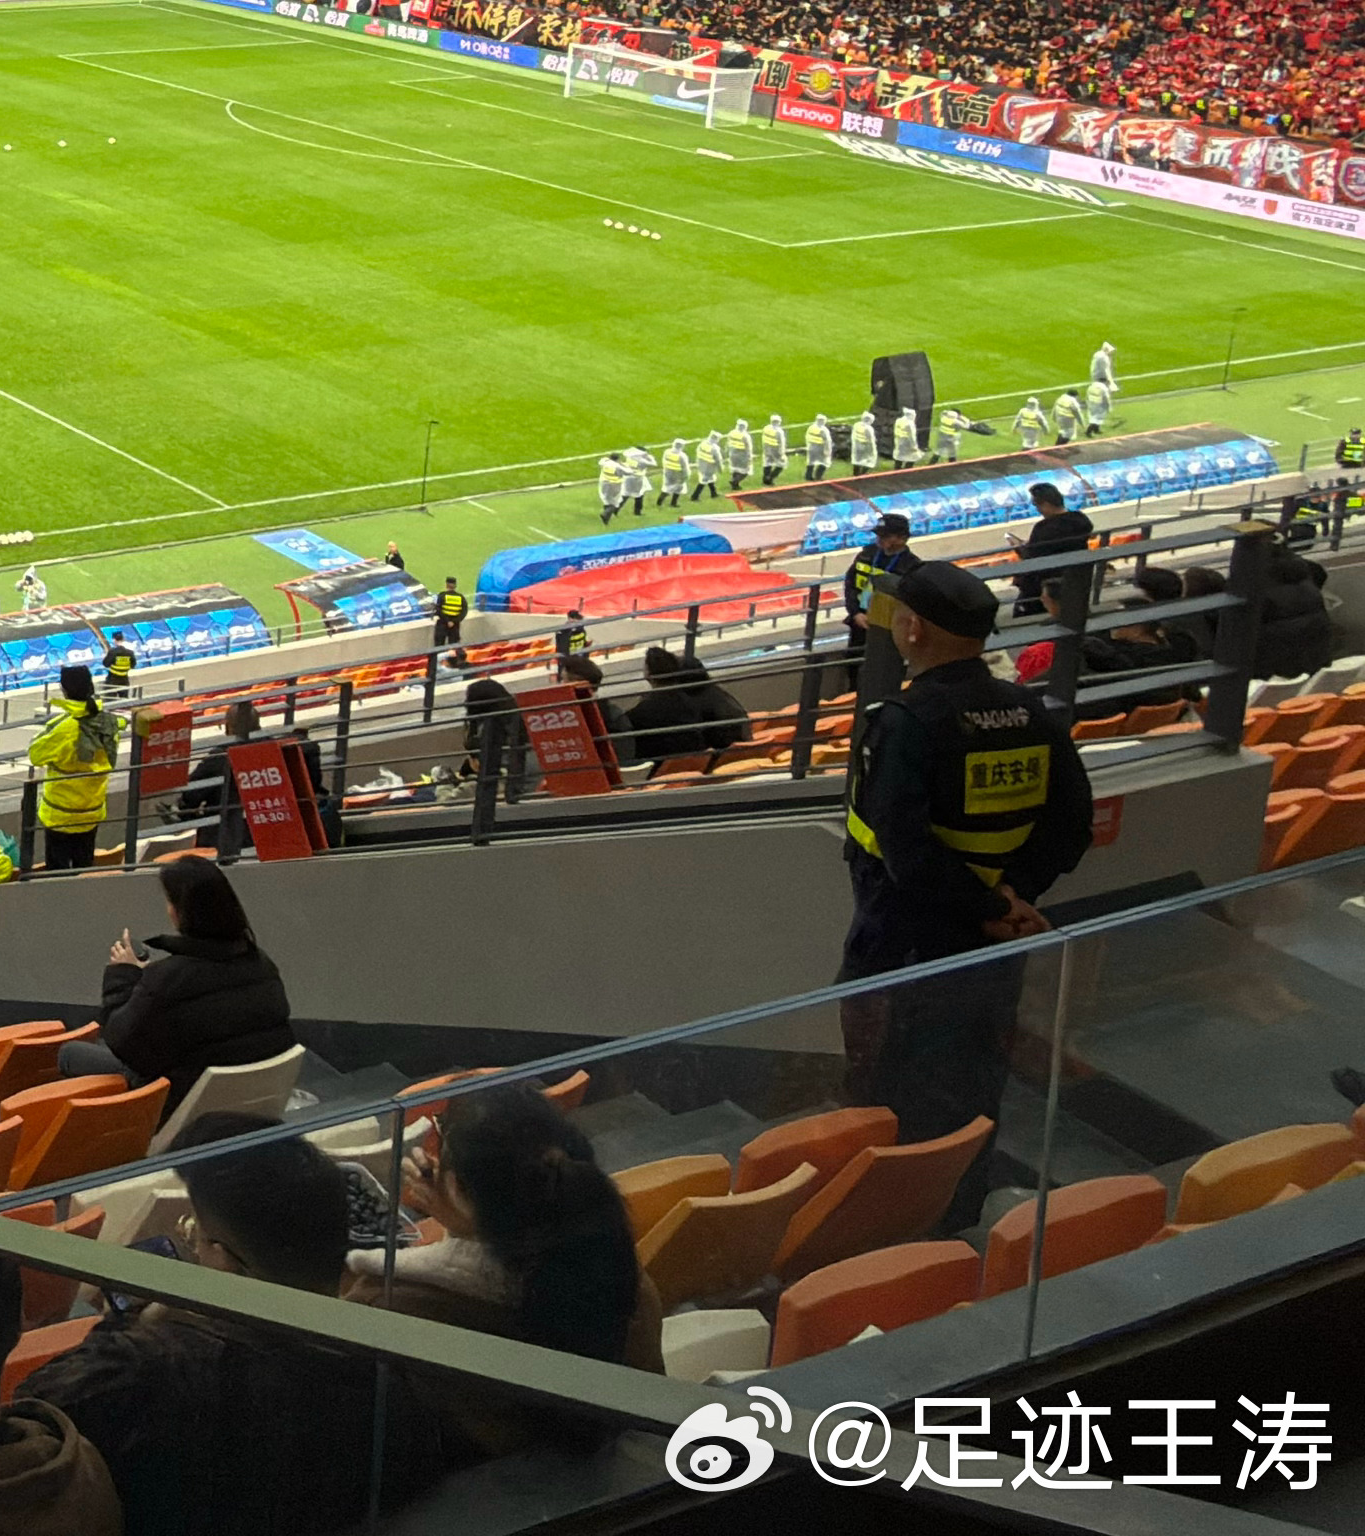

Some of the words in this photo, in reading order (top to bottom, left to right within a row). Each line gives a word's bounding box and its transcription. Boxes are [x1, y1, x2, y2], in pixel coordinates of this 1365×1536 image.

[782, 101, 835, 125] Lenovo
[842, 110, 885, 139] 联想
[528, 709, 581, 732] 222
[148, 727, 190, 747] 222
[238, 766, 283, 790] 221B
[248, 796, 287, 810] 31-34
